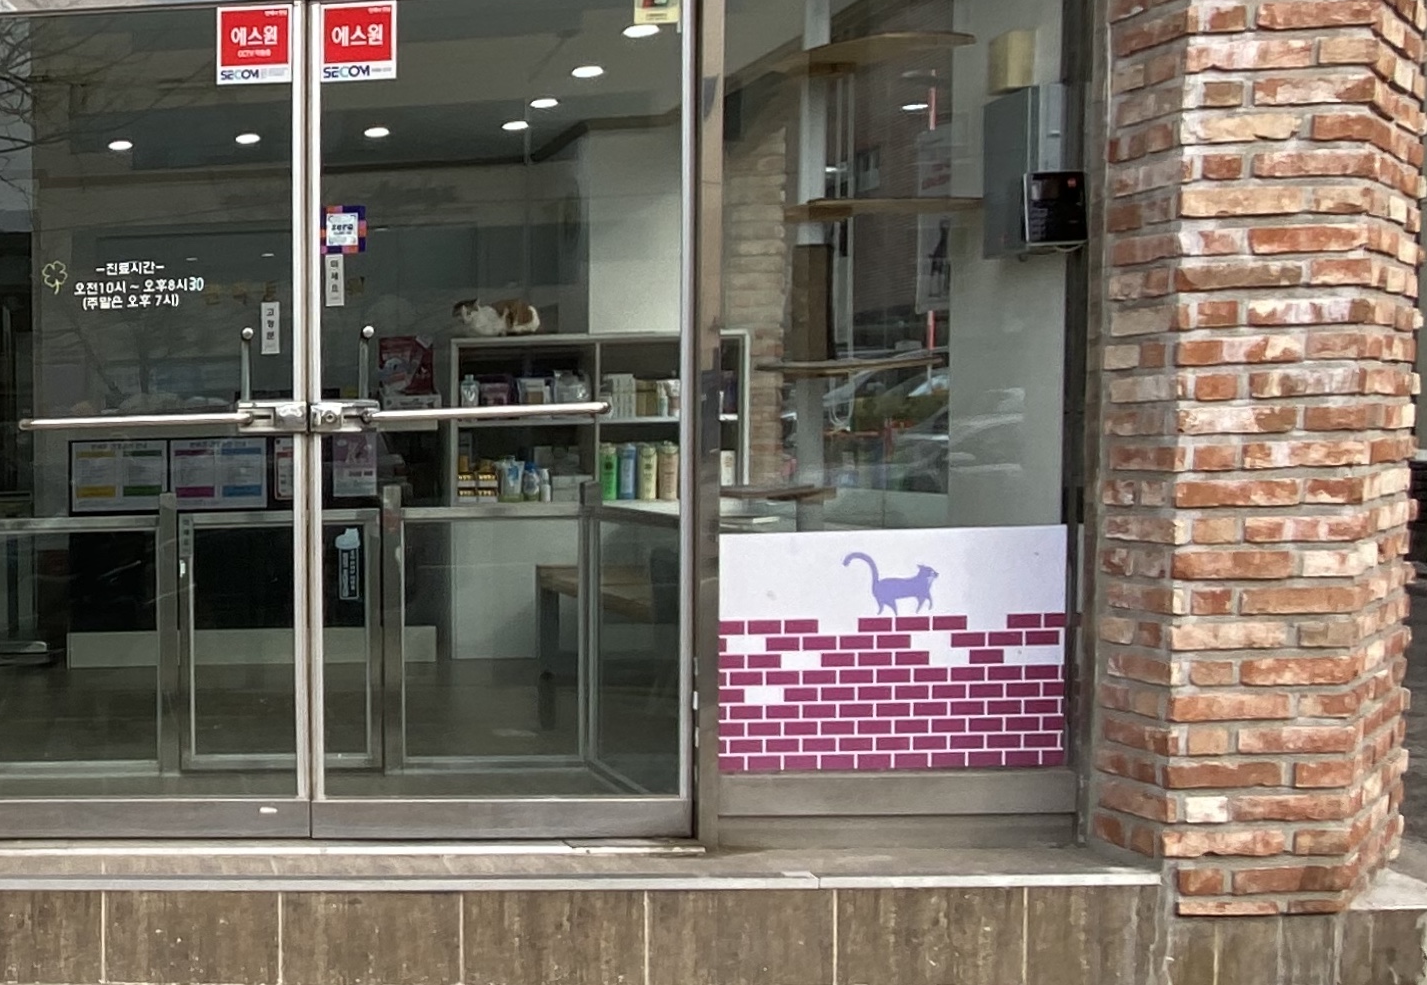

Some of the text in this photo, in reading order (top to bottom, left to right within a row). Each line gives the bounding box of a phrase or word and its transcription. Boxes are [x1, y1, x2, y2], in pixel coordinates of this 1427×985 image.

[230, 25, 278, 47] 에스원
[331, 23, 384, 47] 에스원
[220, 69, 260, 81] SECOM
[323, 65, 371, 79] SECOM
[74, 280, 126, 295] 오전10시
[143, 276, 204, 292] 오후8시30
[82, 297, 123, 310] (주말은
[127, 294, 151, 308] 오후
